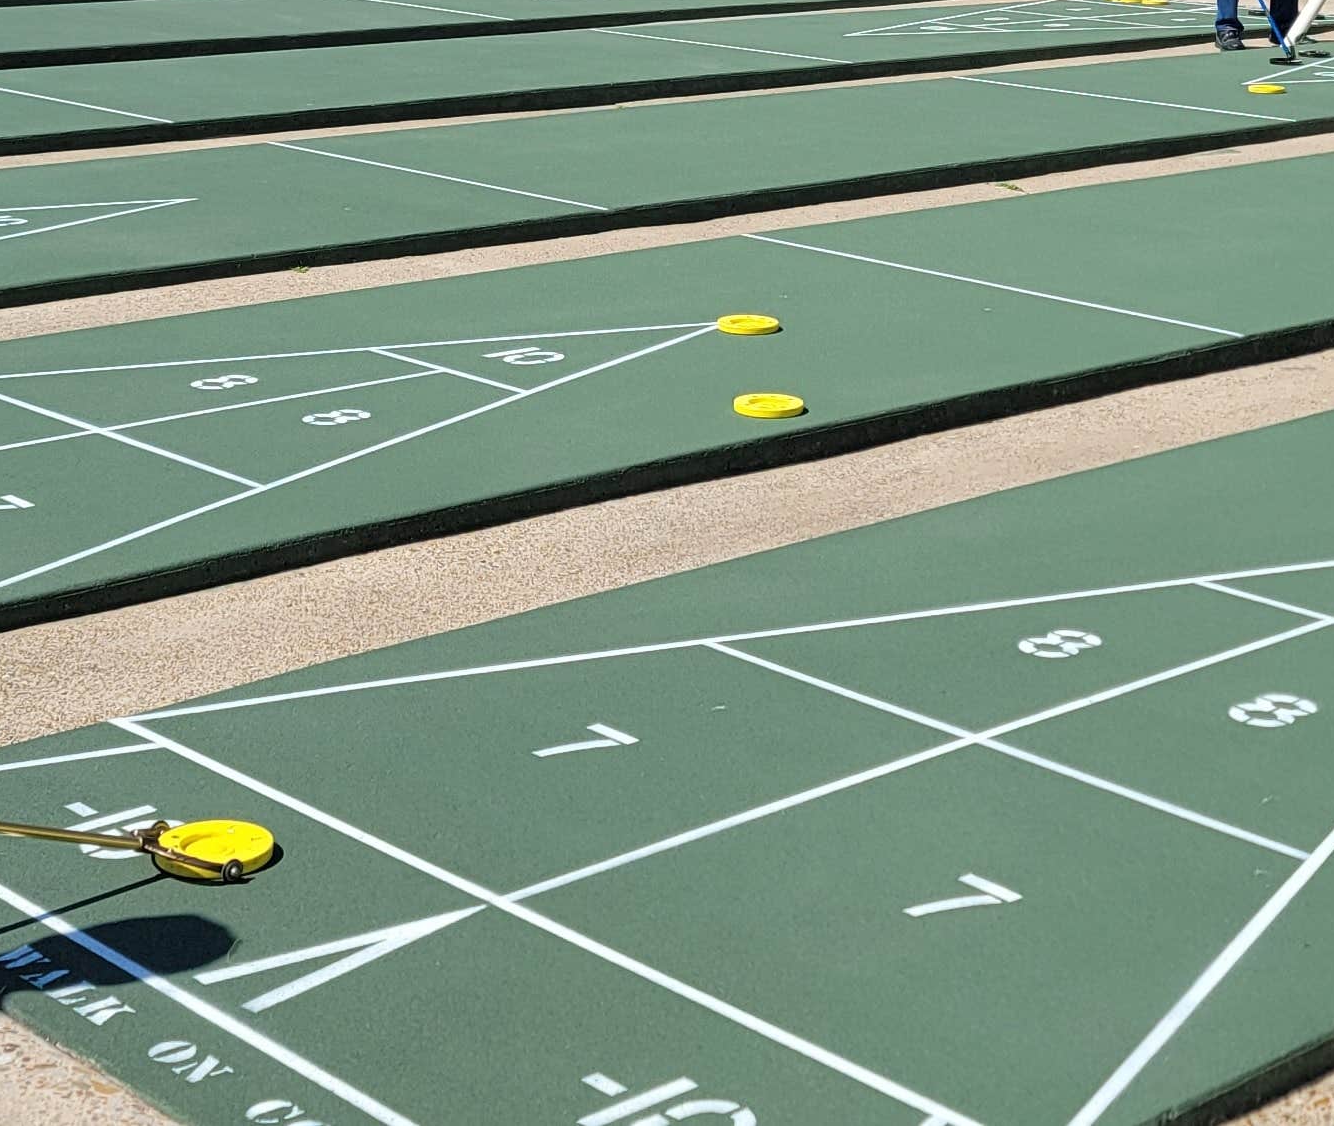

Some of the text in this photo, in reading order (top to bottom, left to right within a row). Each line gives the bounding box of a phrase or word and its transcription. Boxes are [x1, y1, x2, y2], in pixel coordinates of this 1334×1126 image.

[482, 346, 565, 366] 10
[190, 374, 259, 390] 8
[302, 408, 371, 426] 8
[1018, 629, 1102, 659] 8
[1228, 692, 1318, 728] 8
[532, 722, 639, 758] 7
[903, 871, 1024, 918] 7
[147, 1040, 234, 1084] ON
